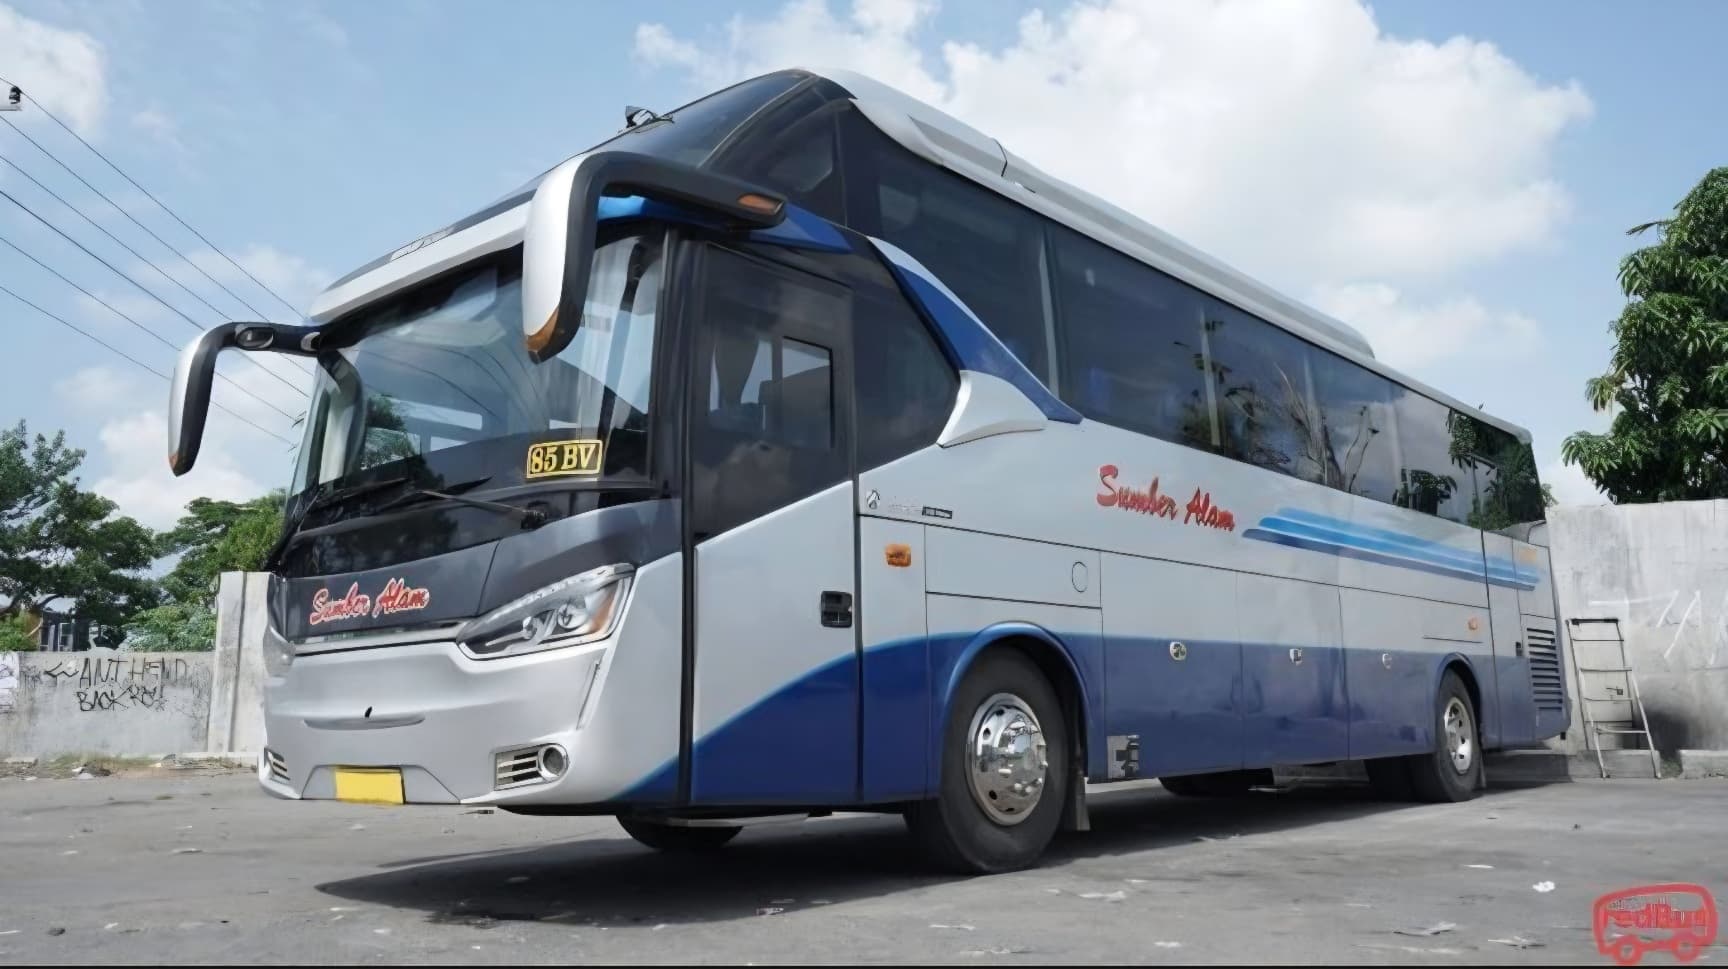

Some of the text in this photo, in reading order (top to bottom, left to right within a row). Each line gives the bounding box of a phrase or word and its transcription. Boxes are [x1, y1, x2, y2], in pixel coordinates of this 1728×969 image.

[531, 443, 596, 473] 85 BV
[1097, 464, 1235, 532] Sumber Alam
[310, 577, 430, 625] Sumber Alam
